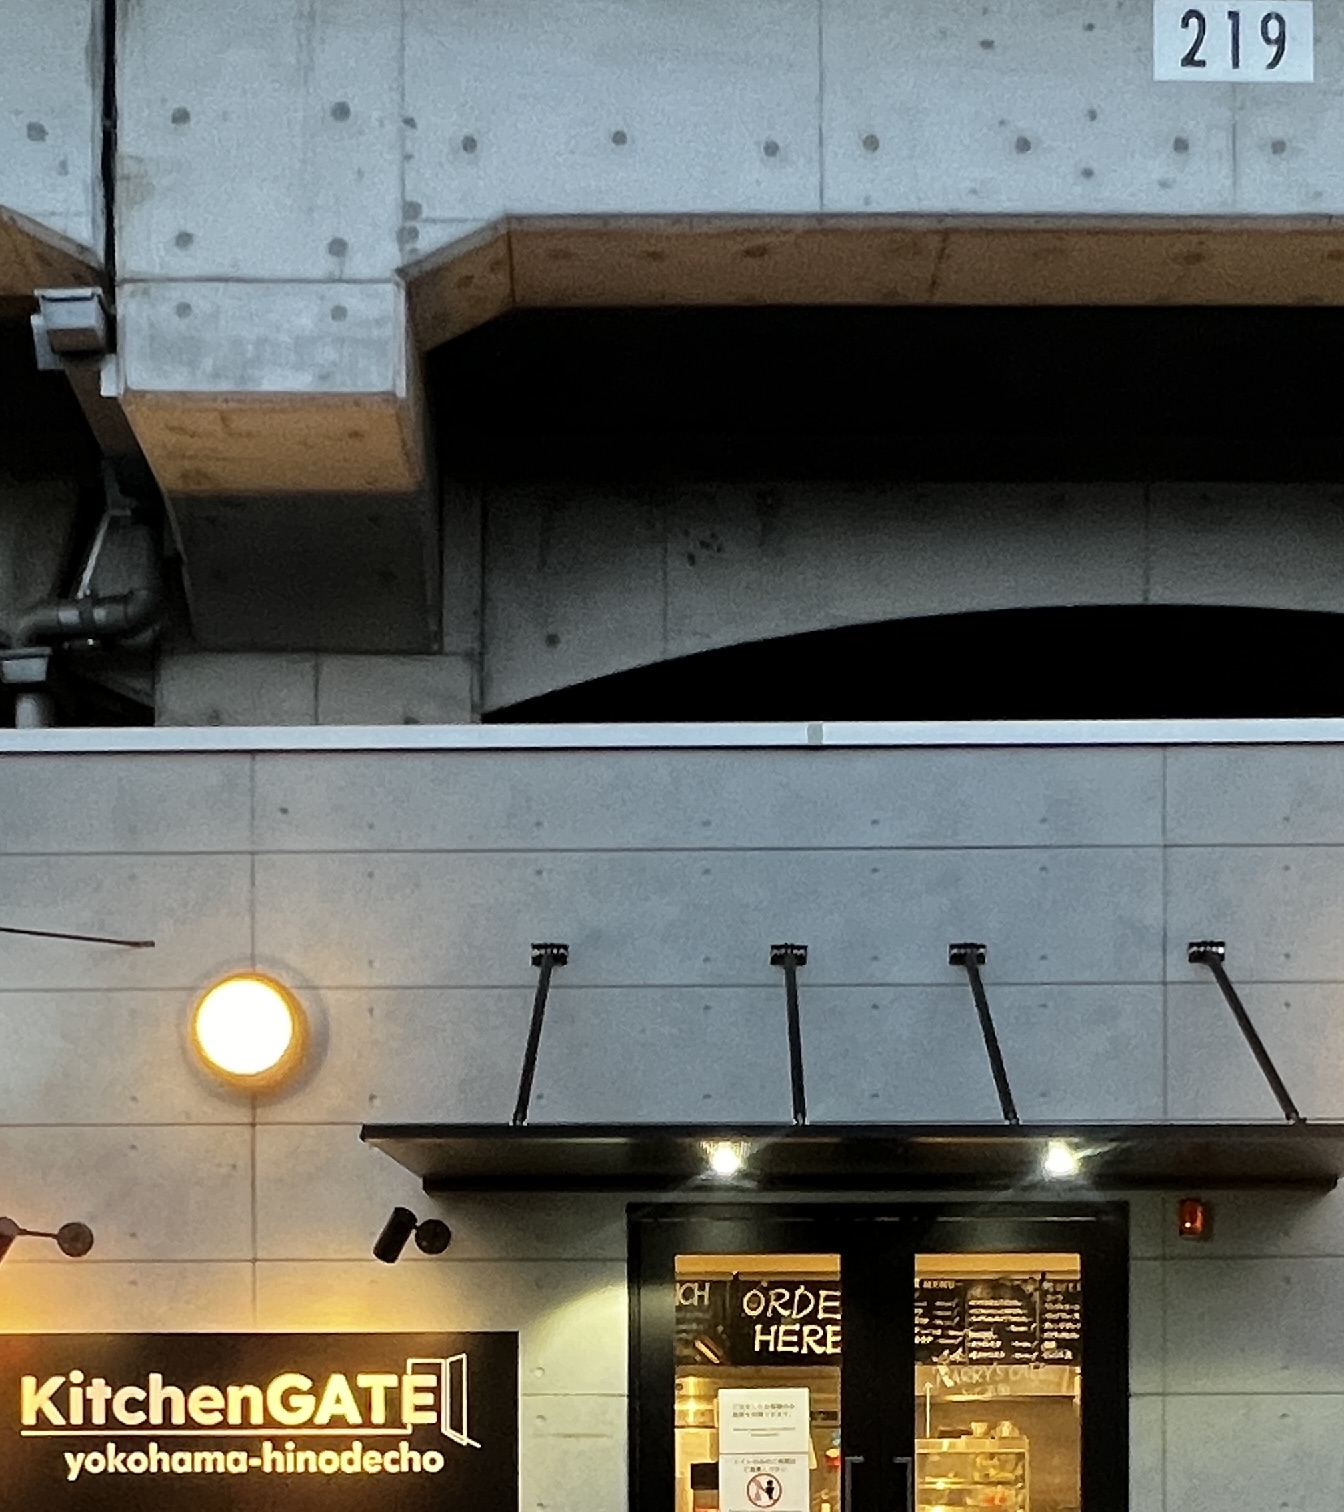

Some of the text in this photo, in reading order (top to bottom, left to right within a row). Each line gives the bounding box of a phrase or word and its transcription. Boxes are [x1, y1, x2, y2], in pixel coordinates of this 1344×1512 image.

[1180, 8, 1287, 70] 219
[754, 1323, 842, 1355] HERE
[20, 1369, 439, 1426] KitchenGATE
[63, 1440, 445, 1481] yokohama-hinodecho
